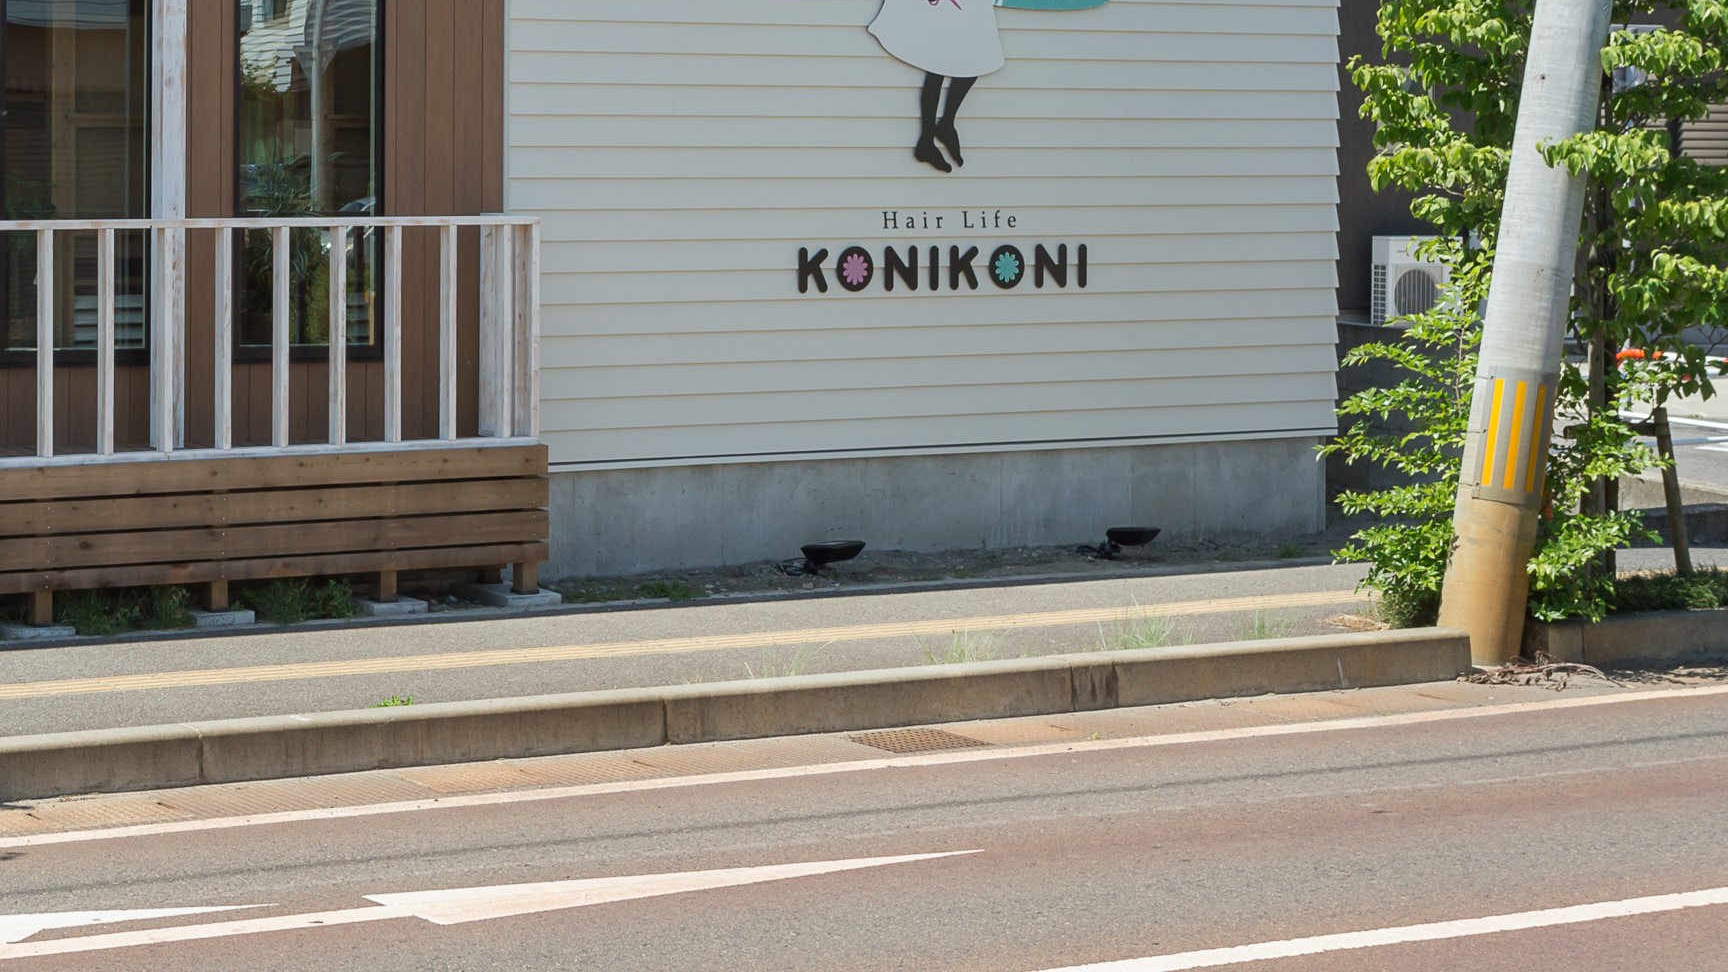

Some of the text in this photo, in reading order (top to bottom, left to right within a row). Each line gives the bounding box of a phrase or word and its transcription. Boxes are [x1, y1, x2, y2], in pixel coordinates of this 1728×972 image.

[882, 210, 1017, 229] Hair Life
[797, 243, 1088, 294] KONIKONI
